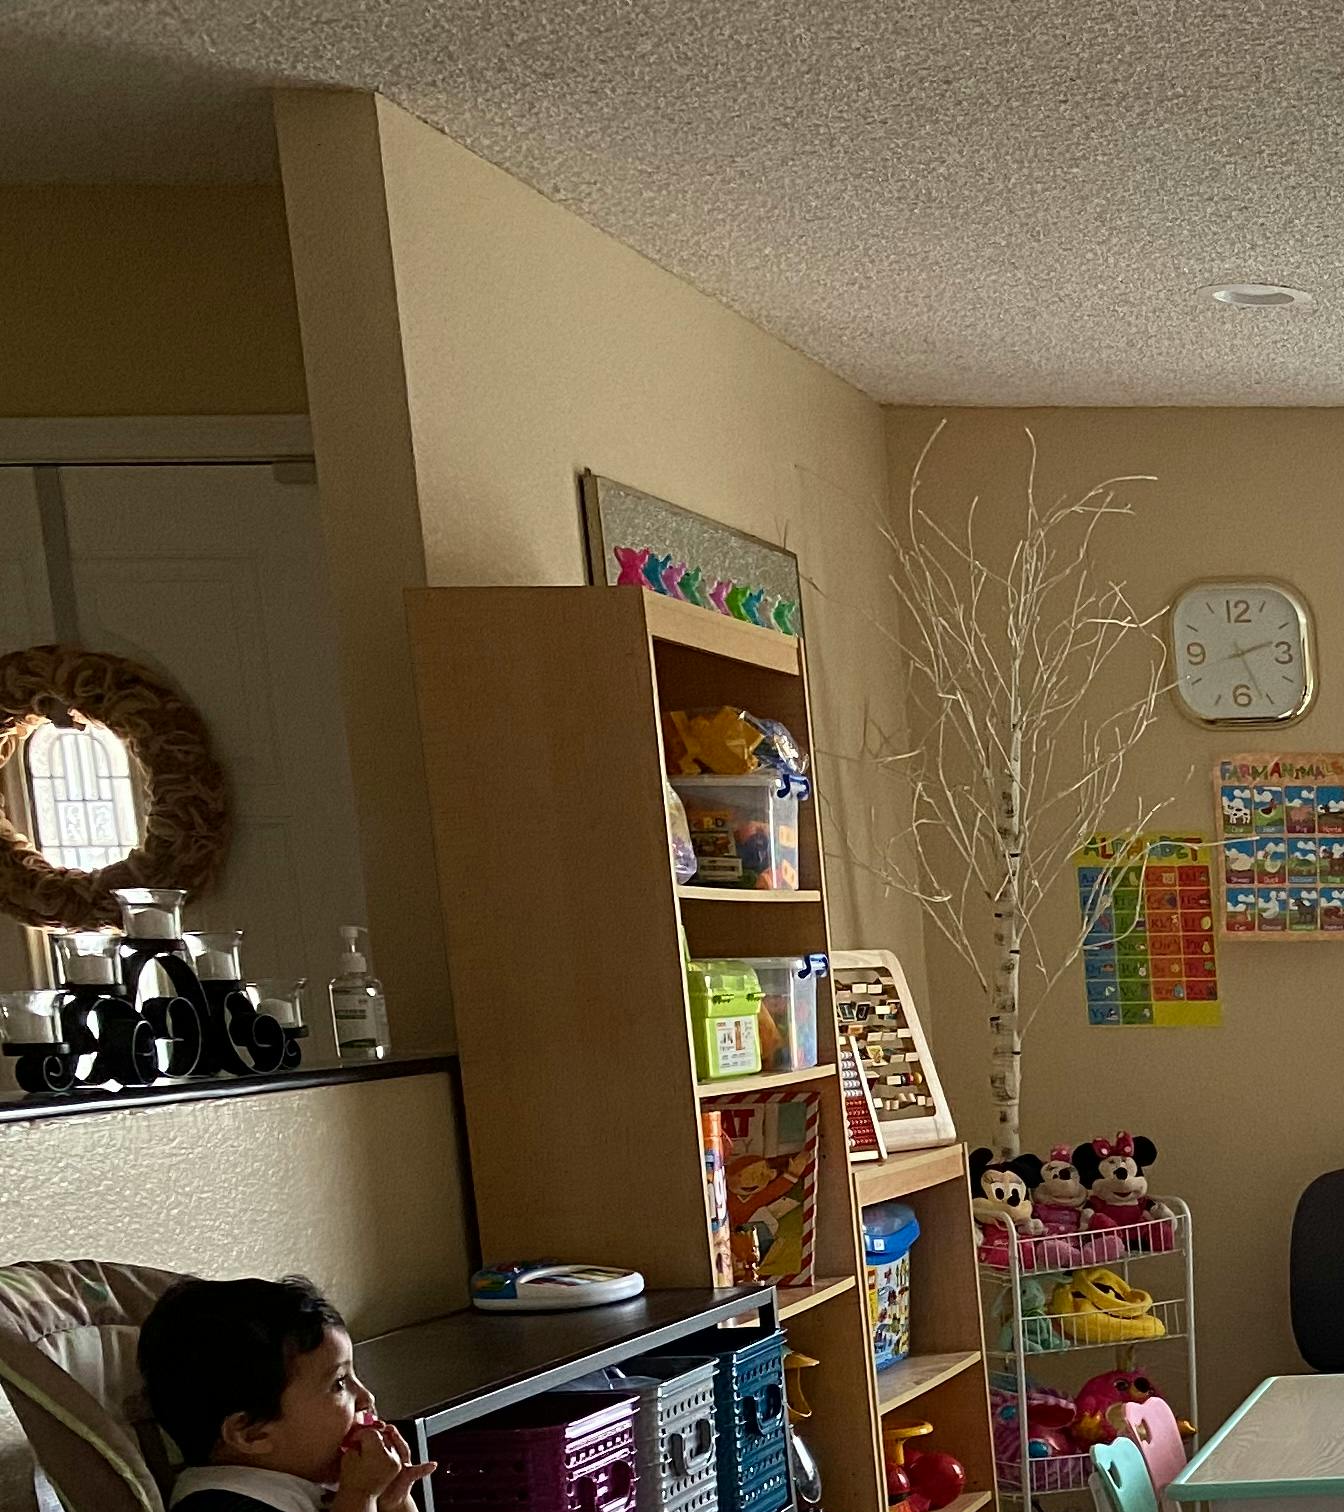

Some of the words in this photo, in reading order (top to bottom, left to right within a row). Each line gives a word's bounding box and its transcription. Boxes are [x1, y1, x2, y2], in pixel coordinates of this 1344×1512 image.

[1226, 600, 1252, 624] 12
[1186, 642, 1206, 665] 9
[1274, 641, 1293, 664] 3
[1232, 684, 1252, 707] 6
